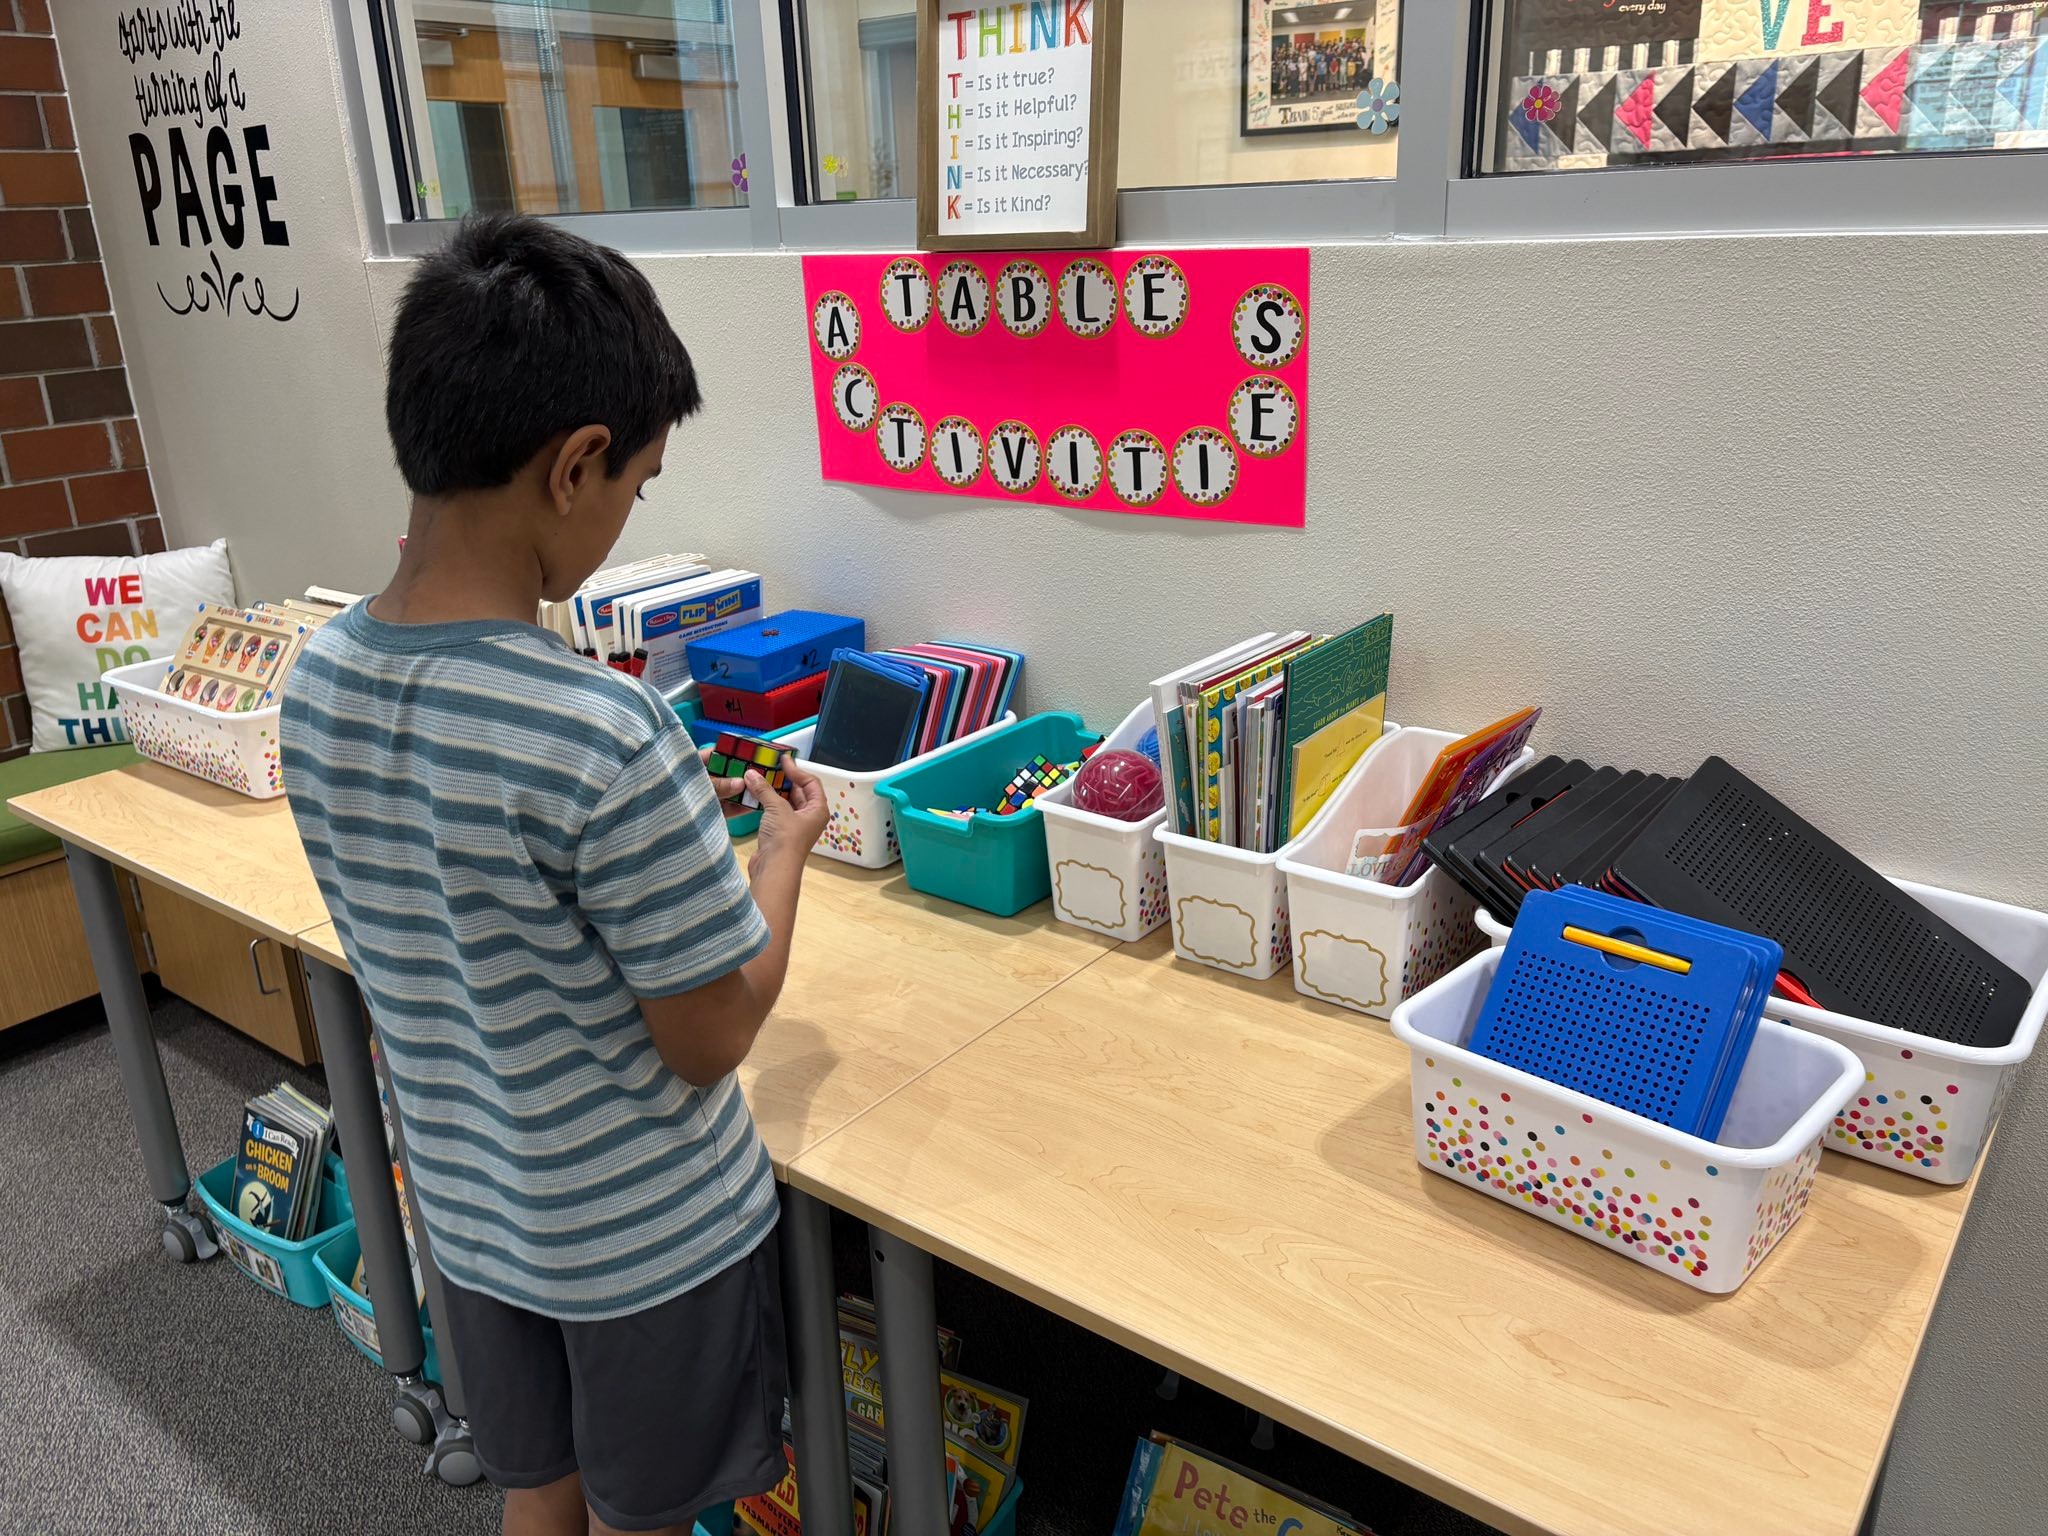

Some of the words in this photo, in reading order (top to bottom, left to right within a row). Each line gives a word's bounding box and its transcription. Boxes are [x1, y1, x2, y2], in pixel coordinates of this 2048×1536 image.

[1619, 4, 1646, 15] every
[1647, 0, 1667, 14] day
[166, 0, 211, 55] with
[210, 0, 241, 52] the
[947, 0, 1092, 61] THINK
[133, 69, 204, 129] turning
[205, 51, 228, 128] of
[229, 68, 246, 111] a
[947, 72, 963, 99] T
[978, 74, 992, 91] Is
[996, 73, 1009, 90] it
[1013, 67, 1055, 88] true?
[947, 104, 962, 130] H
[978, 103, 992, 120] Is
[996, 101, 1009, 118] it
[1014, 94, 1077, 119] Helpful?
[950, 134, 960, 160] I
[978, 134, 992, 151] Is
[996, 132, 1008, 149] it
[1012, 126, 1084, 151] Inspiring?
[128, 124, 290, 250] PAGE
[947, 165, 962, 190] N
[977, 167, 990, 183] Is
[995, 164, 1007, 181] it
[1012, 160, 1089, 181] Necessary?
[947, 194, 961, 220] K
[977, 198, 990, 214] Is
[995, 196, 1007, 213] it
[1011, 194, 1051, 213] Kind?
[894, 272, 1169, 326] TABLE
[85, 575, 143, 606] WE
[76, 608, 159, 643] CAN
[682, 607, 705, 619] FLIP
[679, 630, 692, 639] GAME
[58, 717, 127, 745] THI
[245, 1138, 294, 1174] CHICKEN
[257, 1163, 290, 1195] BROOM
[841, 1339, 880, 1375] LY
[1173, 1460, 1249, 1529] Pete
[1253, 1508, 1277, 1525] the
[741, 1500, 780, 1536] TASMAN
[760, 1495, 801, 1535] WOLVERI
